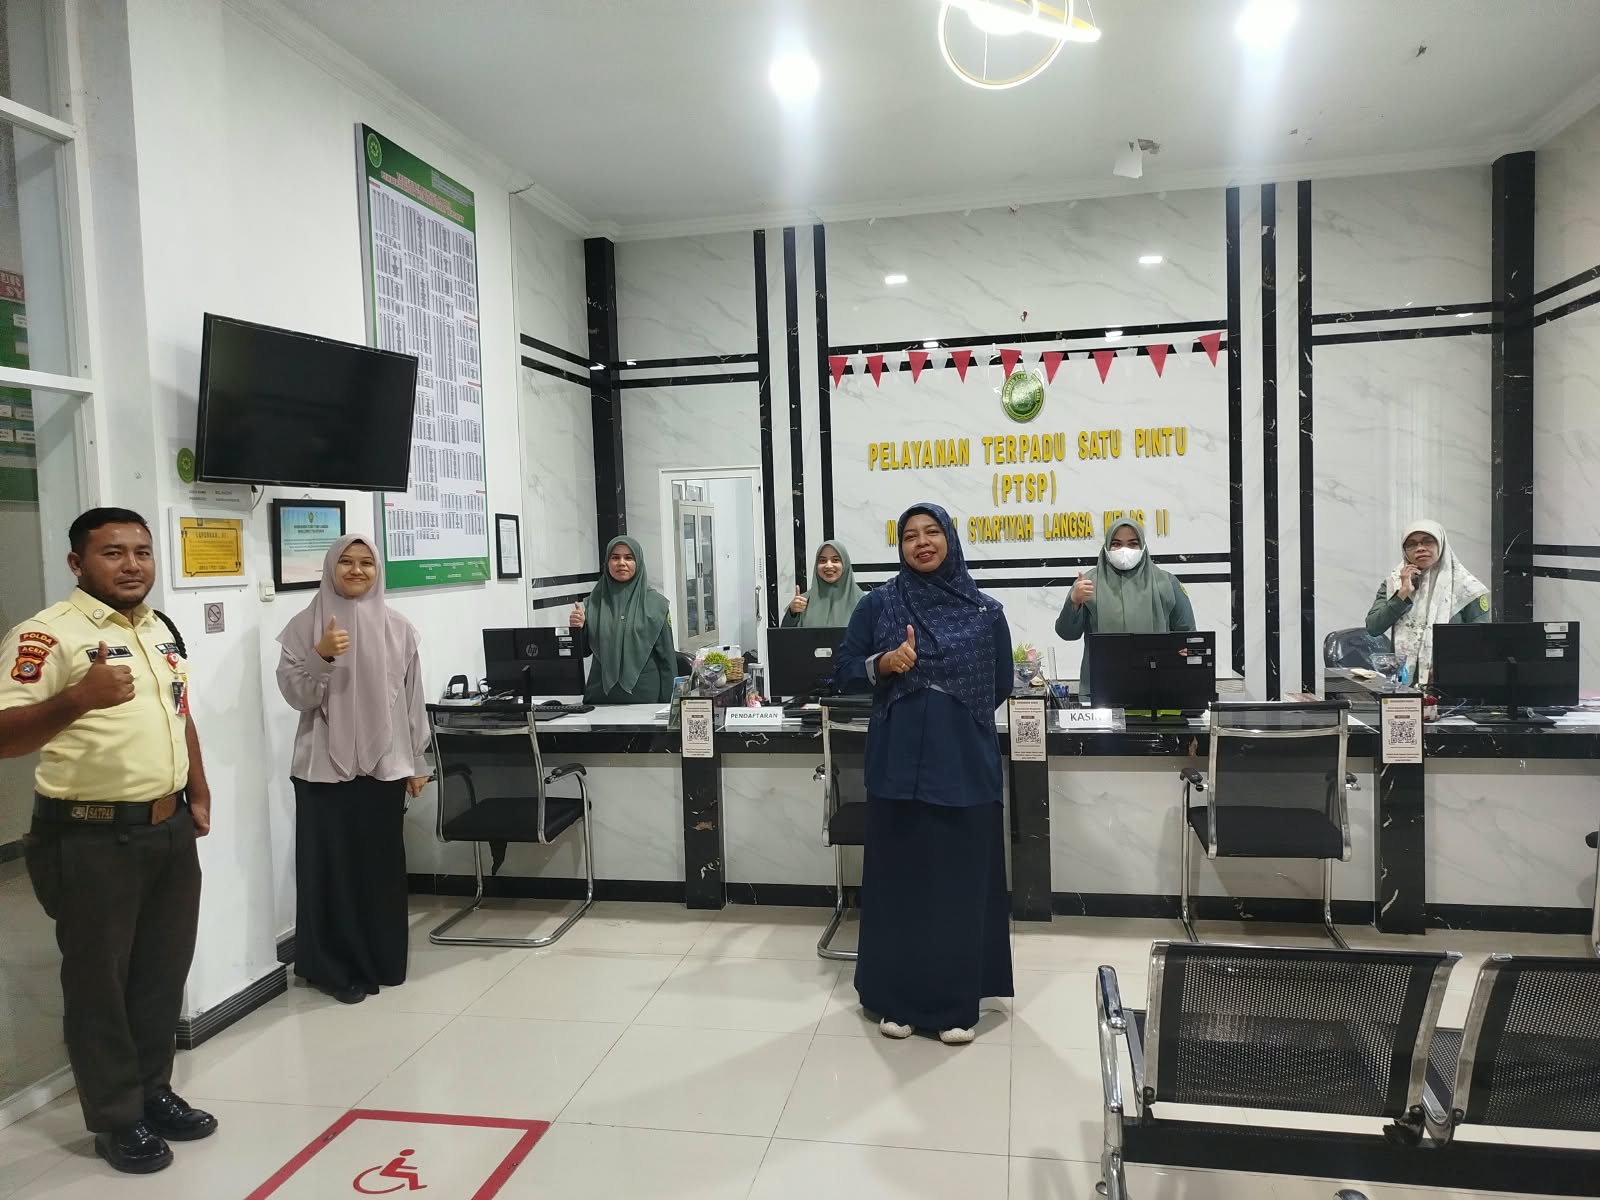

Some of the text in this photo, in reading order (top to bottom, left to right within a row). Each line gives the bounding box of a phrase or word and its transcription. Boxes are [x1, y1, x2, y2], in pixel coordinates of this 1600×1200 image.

[868, 427, 1187, 471] PELAYANAN TERPADU SATU PINTU
[992, 470, 1057, 507] (PTSP)
[968, 514, 1034, 543] SYAR'IYAH
[1044, 511, 1094, 540] LANGSA
[1155, 508, 1169, 537] II
[23, 633, 52, 645] POLDA
[22, 647, 45, 656] ACEH
[526, 644, 539, 657] hp
[1070, 712, 1102, 721] KASI
